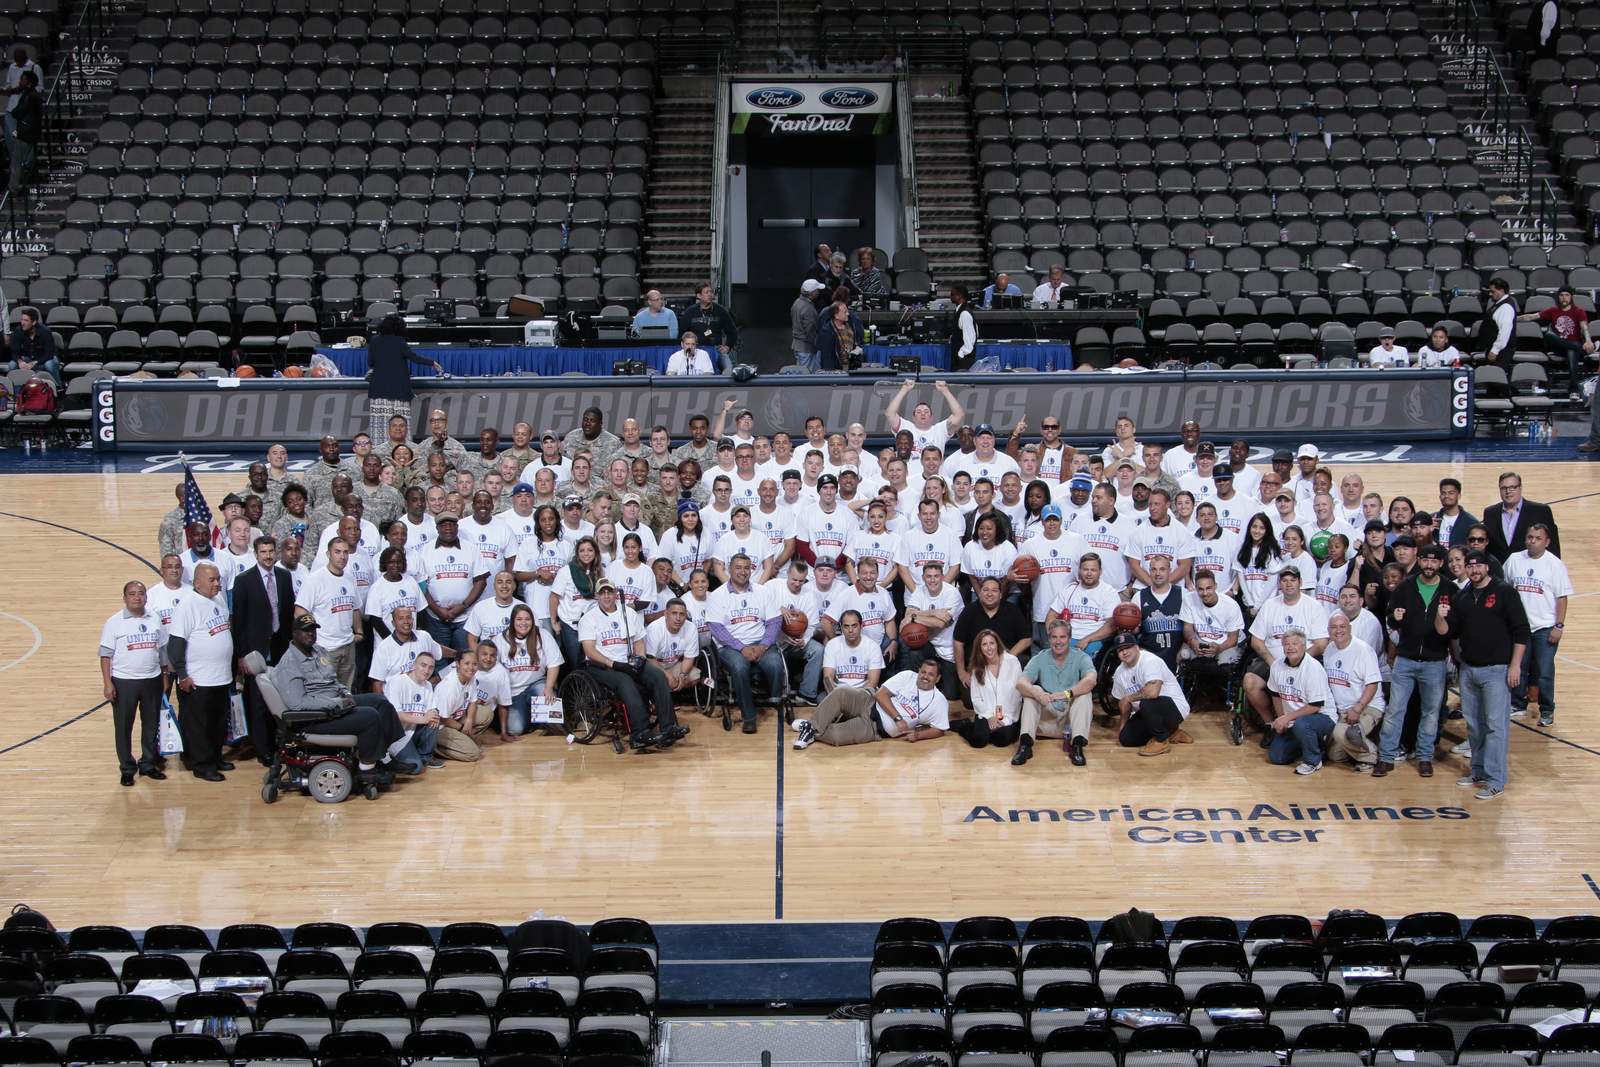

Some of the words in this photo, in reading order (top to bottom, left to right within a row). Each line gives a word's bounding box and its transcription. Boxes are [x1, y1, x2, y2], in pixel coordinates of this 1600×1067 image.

[757, 90, 793, 106] Ford
[830, 90, 866, 106] Ford
[769, 114, 855, 134] FanDuel
[1048, 383, 1390, 431] MAVERICKS
[183, 394, 372, 437] DALLAS
[733, 496, 760, 505] UNITE
[815, 531, 844, 540] UNITED
[1084, 534, 1120, 545] UNITED
[1144, 545, 1175, 554] UNITED
[915, 552, 946, 560] UNITED
[434, 563, 469, 572] UNITED
[1514, 576, 1544, 587] UNITED
[1148, 620, 1178, 632] DALLAS
[1156, 633, 1171, 648] 41
[1127, 825, 1325, 844] Center
